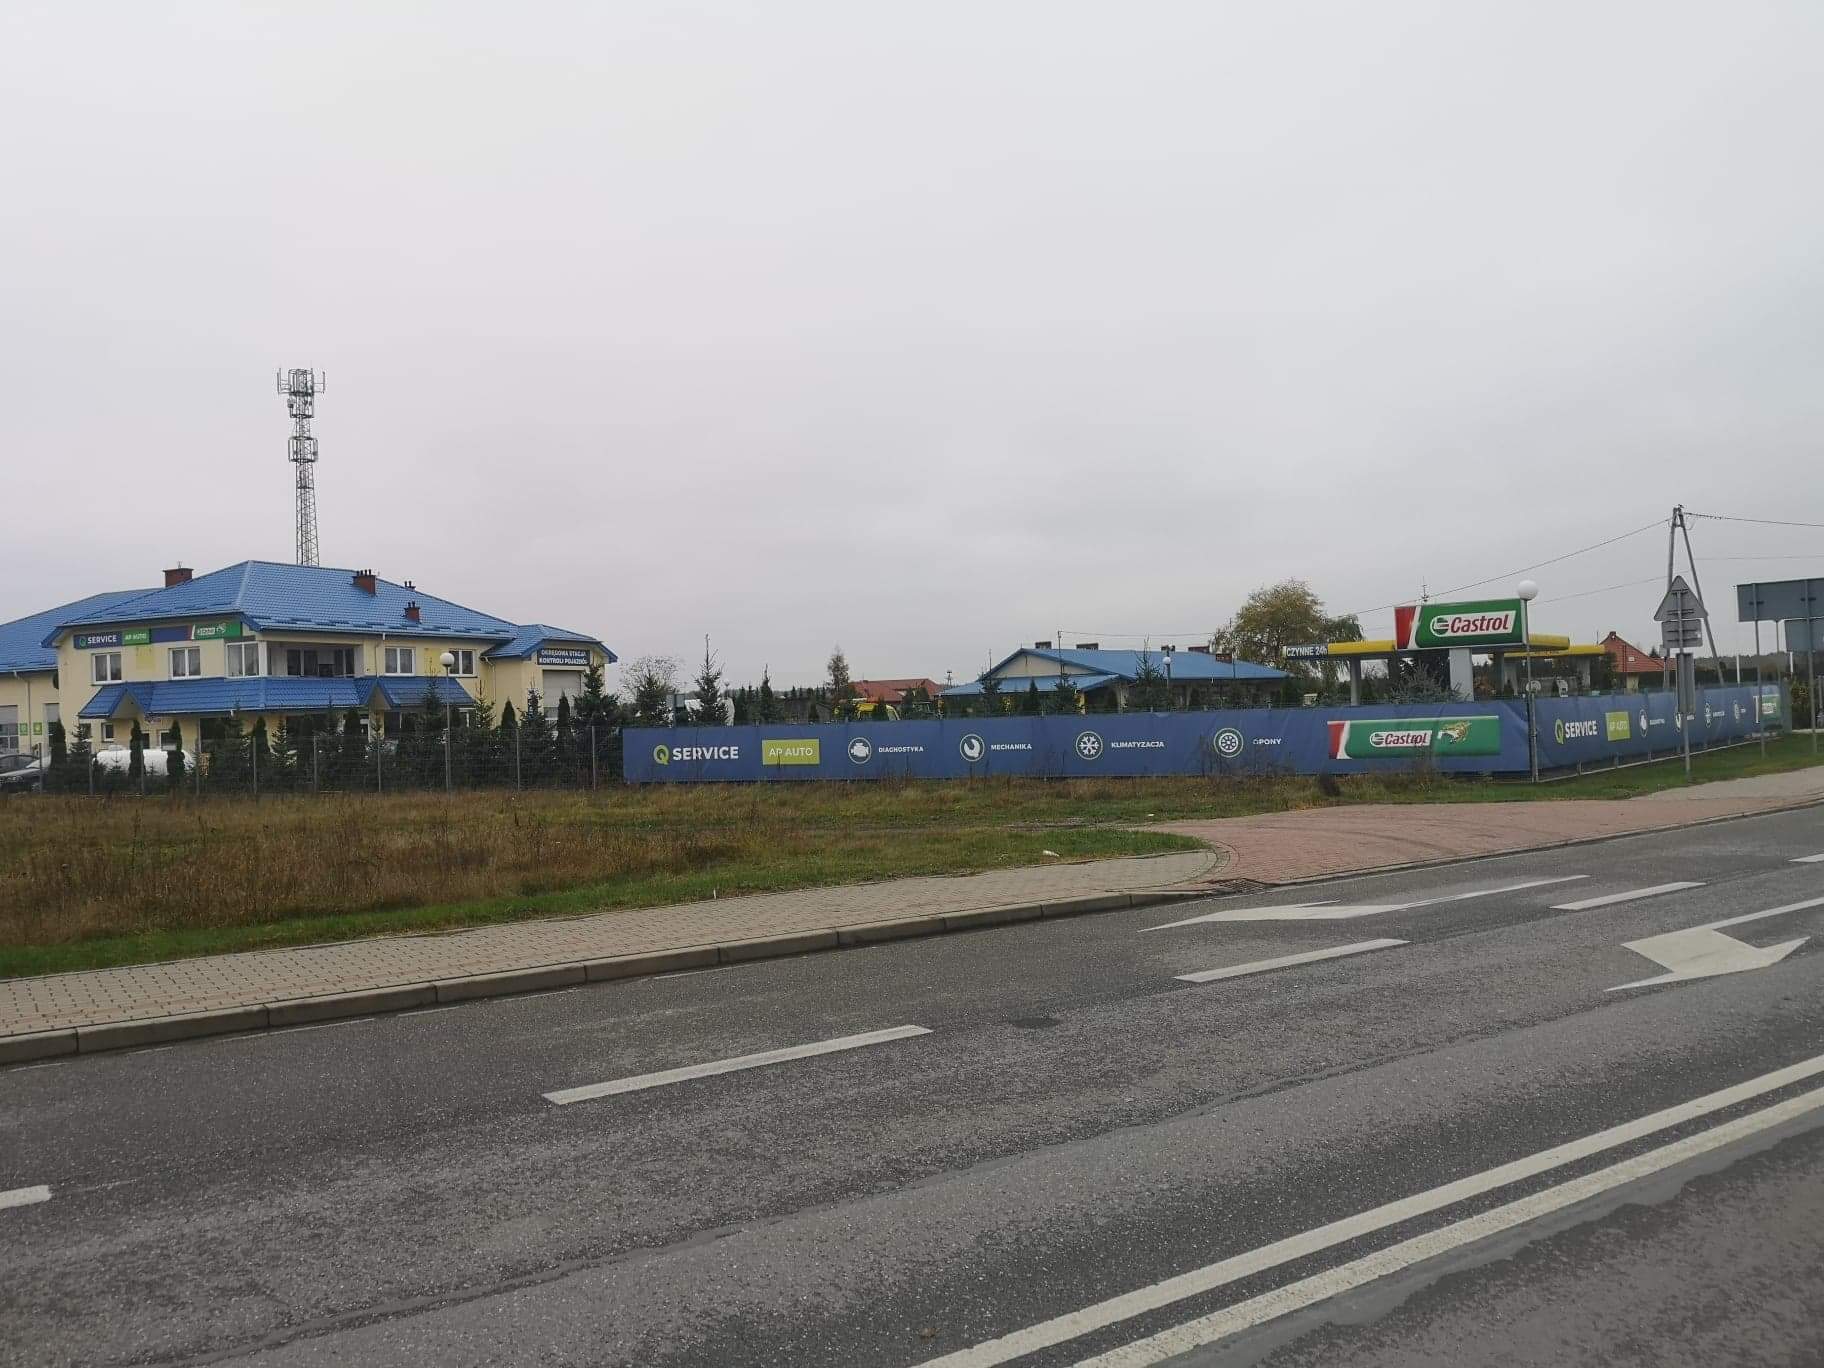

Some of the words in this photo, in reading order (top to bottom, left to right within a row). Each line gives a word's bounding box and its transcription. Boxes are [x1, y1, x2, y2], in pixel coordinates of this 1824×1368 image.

[1451, 614, 1509, 633] Castrol
[87, 634, 117, 644] SERVICE
[1286, 646, 1314, 657] CZYNNE
[1315, 646, 1327, 656] 24h
[1565, 720, 1598, 738] SERVICE
[1252, 737, 1282, 745] OPONY
[1384, 732, 1429, 746] Castrol
[990, 743, 1032, 751] MECHANIKA
[1111, 741, 1164, 749] KLIMATYZACJA
[653, 744, 669, 765] Q
[672, 746, 739, 761] SERVICE
[767, 748, 783, 757] AP
[785, 747, 814, 757] AUTO
